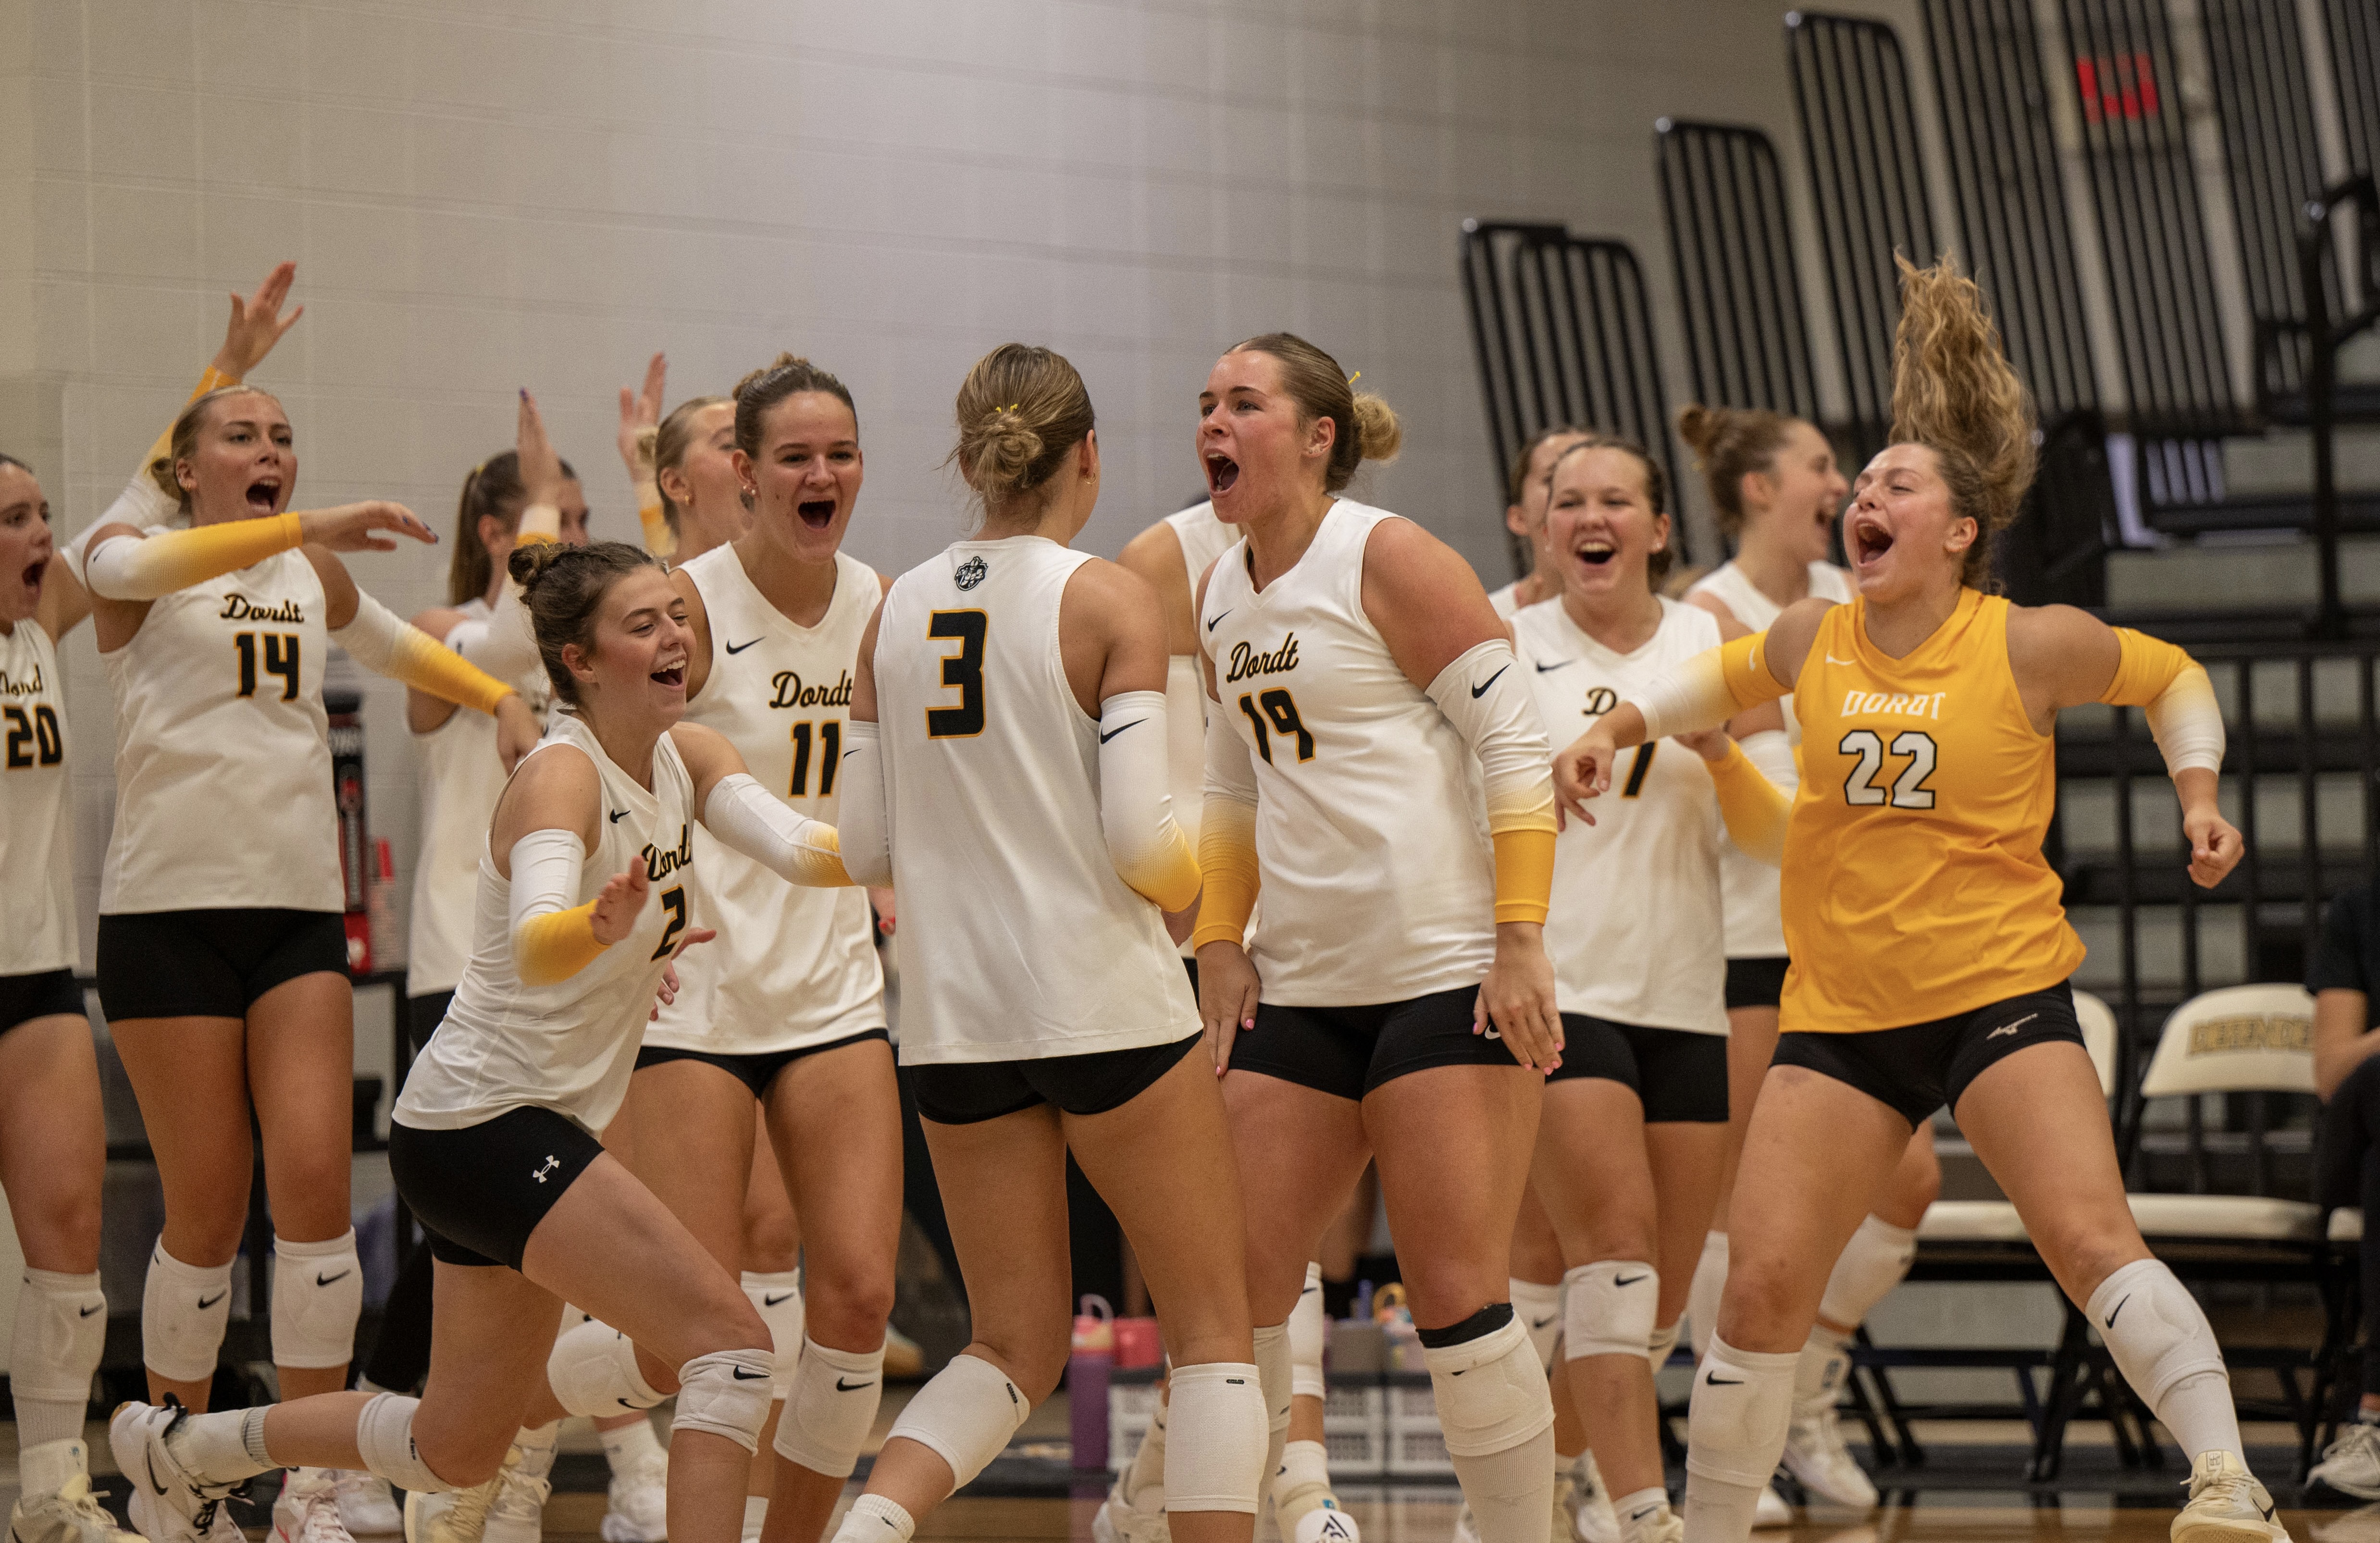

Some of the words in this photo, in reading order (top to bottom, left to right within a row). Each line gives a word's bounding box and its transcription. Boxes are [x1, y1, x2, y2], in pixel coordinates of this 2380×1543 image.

[0, 663, 43, 696] ord
[233, 630, 300, 703] 14
[769, 669, 852, 708] Dordt
[925, 608, 989, 740] 3
[1226, 631, 1299, 683] Dordt
[1, 703, 62, 770] 20
[788, 719, 842, 798] 11
[1238, 686, 1316, 766] 19
[1838, 729, 1937, 810] 22
[641, 823, 692, 881] Dord
[650, 883, 687, 963] 2
